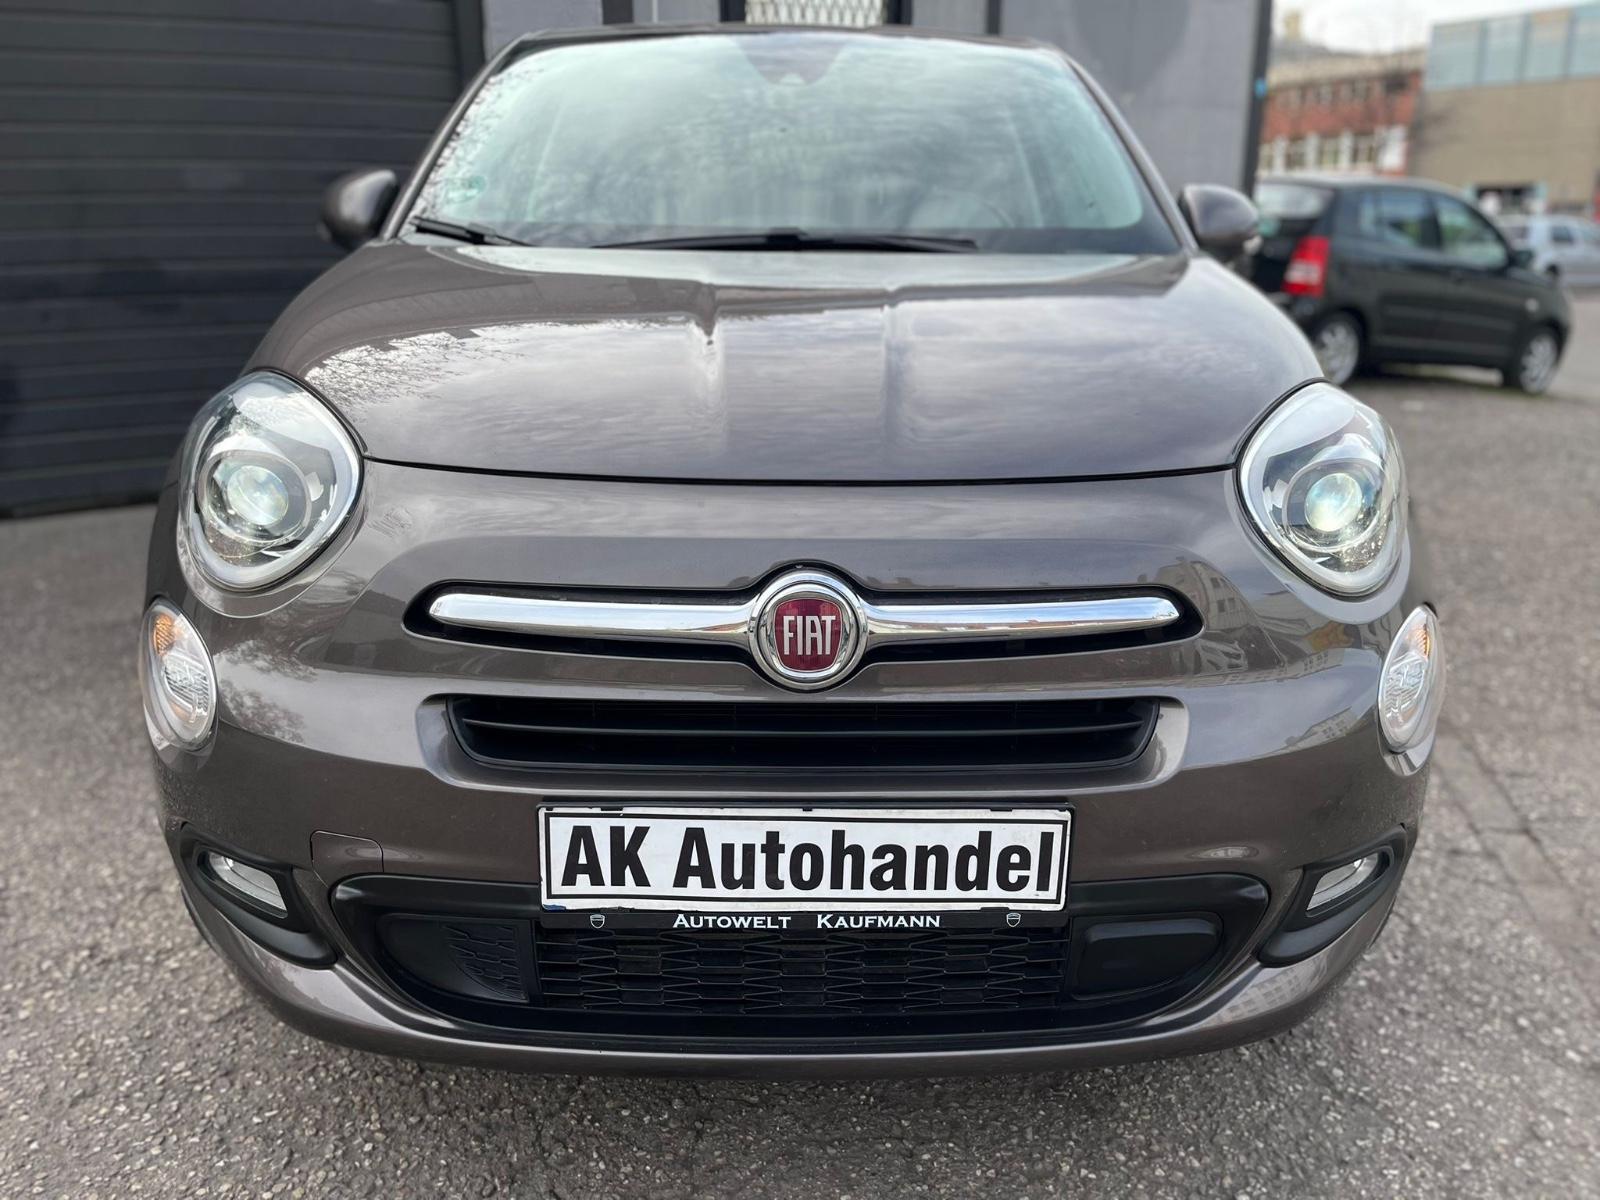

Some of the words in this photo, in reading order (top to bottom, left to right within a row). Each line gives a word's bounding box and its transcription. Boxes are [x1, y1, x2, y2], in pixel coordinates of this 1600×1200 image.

[783, 615, 836, 656] FIAT
[561, 825, 651, 888] AK
[672, 826, 1057, 892] Autohandel
